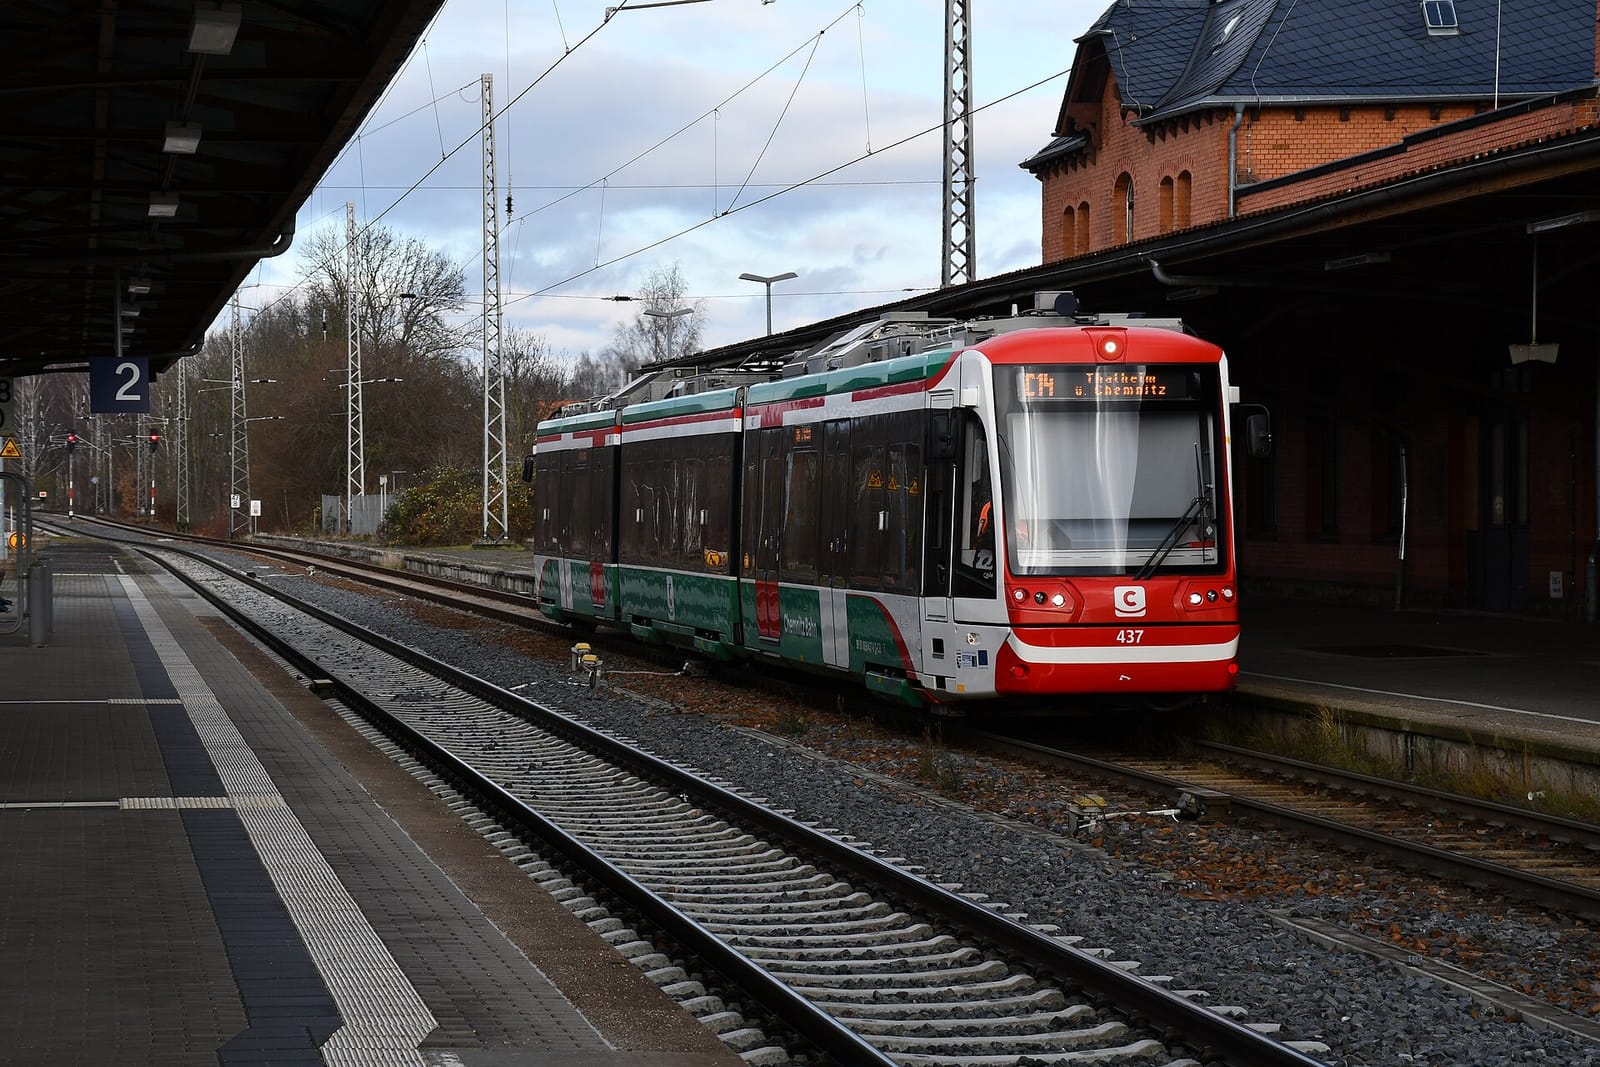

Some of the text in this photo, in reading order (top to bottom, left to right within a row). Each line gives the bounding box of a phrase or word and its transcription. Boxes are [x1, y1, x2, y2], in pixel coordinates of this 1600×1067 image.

[115, 362, 141, 401] 2
[1025, 373, 1054, 397] C14
[1085, 372, 1157, 384] Thalheim
[1095, 385, 1166, 396] Chemnitz
[1116, 629, 1144, 645] 437
